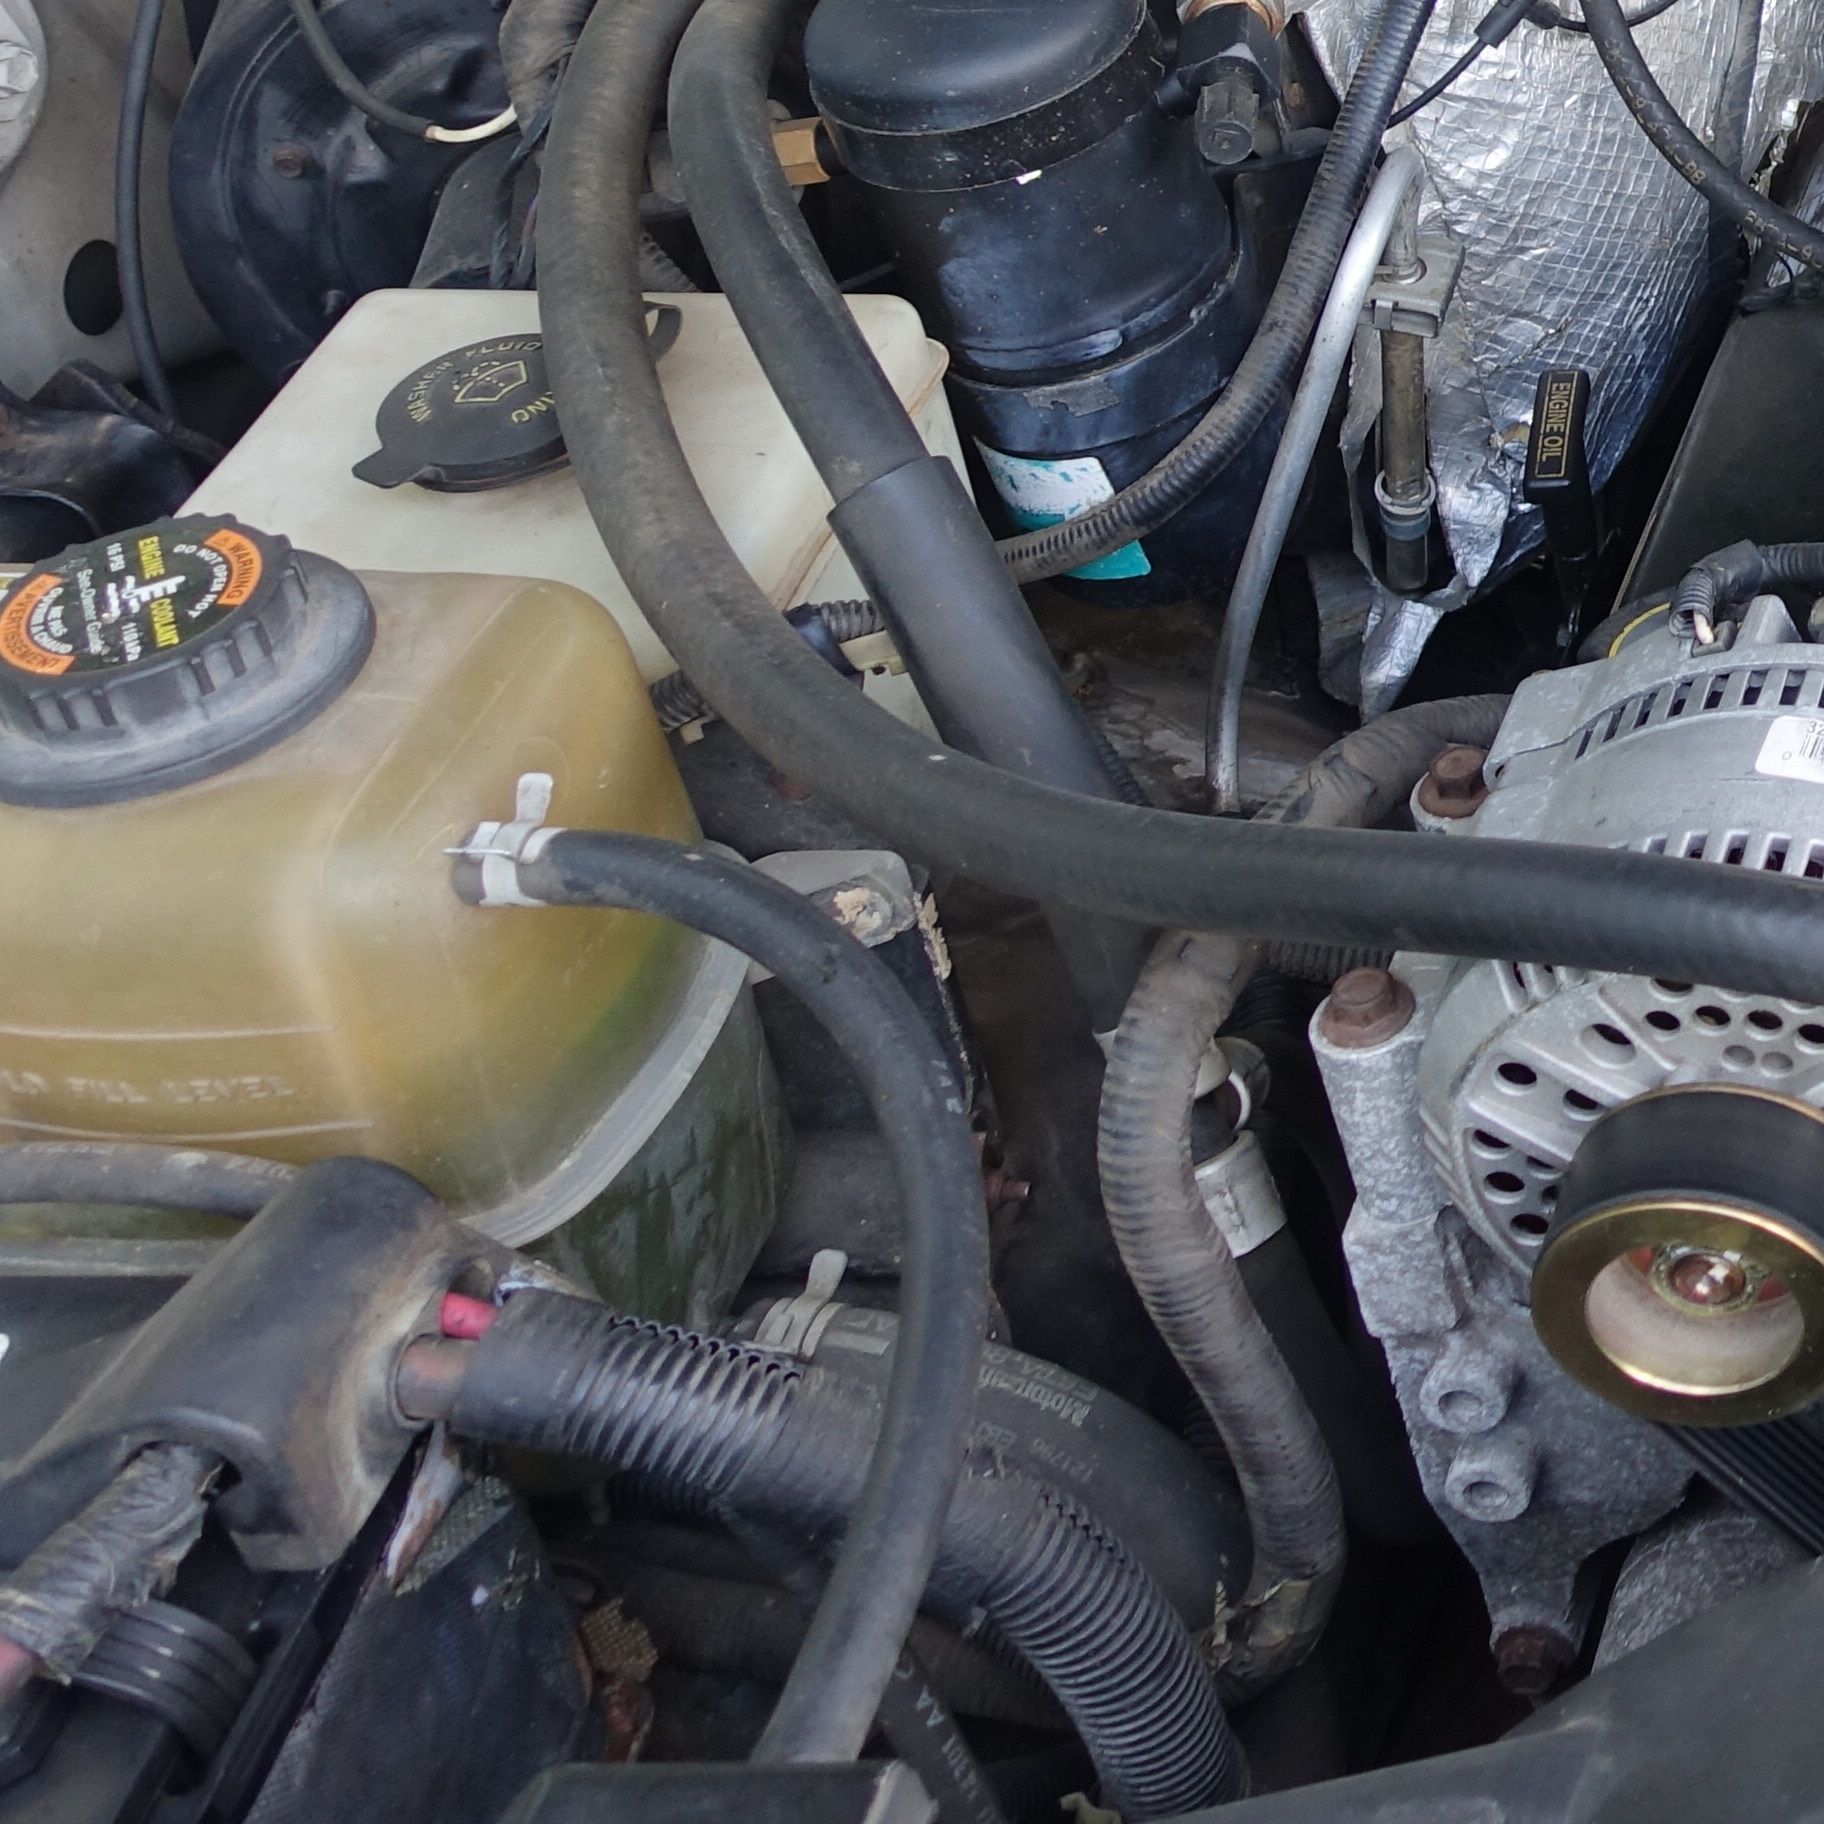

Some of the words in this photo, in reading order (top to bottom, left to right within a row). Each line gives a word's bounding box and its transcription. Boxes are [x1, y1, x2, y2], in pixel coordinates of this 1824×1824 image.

[406, 360, 455, 424] WASHER
[465, 340, 543, 360] FLUID
[1545, 382, 1572, 433] ENGINE
[1541, 436, 1563, 463] OIL
[137, 535, 165, 580] ENGINE
[173, 544, 196, 555] DO
[197, 548, 219, 567] NOT
[230, 542, 253, 599] WARNING
[150, 597, 181, 648] COOLANT
